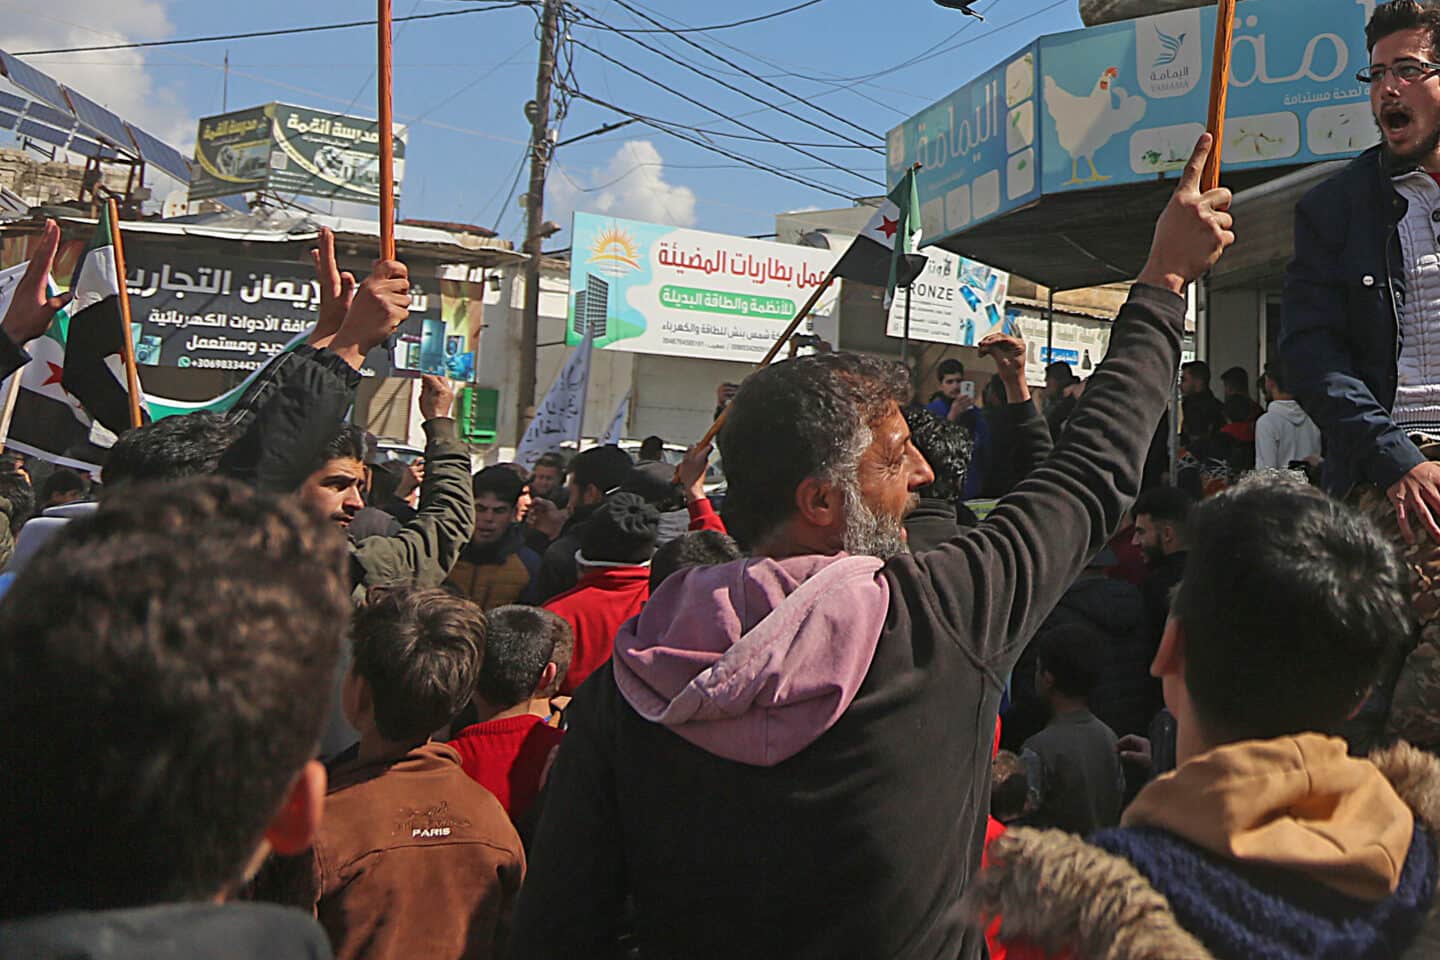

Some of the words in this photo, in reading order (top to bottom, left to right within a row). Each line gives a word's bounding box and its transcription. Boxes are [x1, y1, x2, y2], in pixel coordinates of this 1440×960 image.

[1150, 65, 1188, 81] اليمامة
[915, 81, 998, 169] اليمامة
[658, 242, 726, 276] المضيئة
[126, 264, 232, 298] التجاري
[730, 254, 792, 288] بطاريات
[704, 291, 748, 312] والطاقة
[149, 309, 226, 330] الكهربائية
[230, 312, 278, 333] الأدوات
[187, 334, 258, 356] ومستعمل
[412, 827, 451, 838] PARIS
